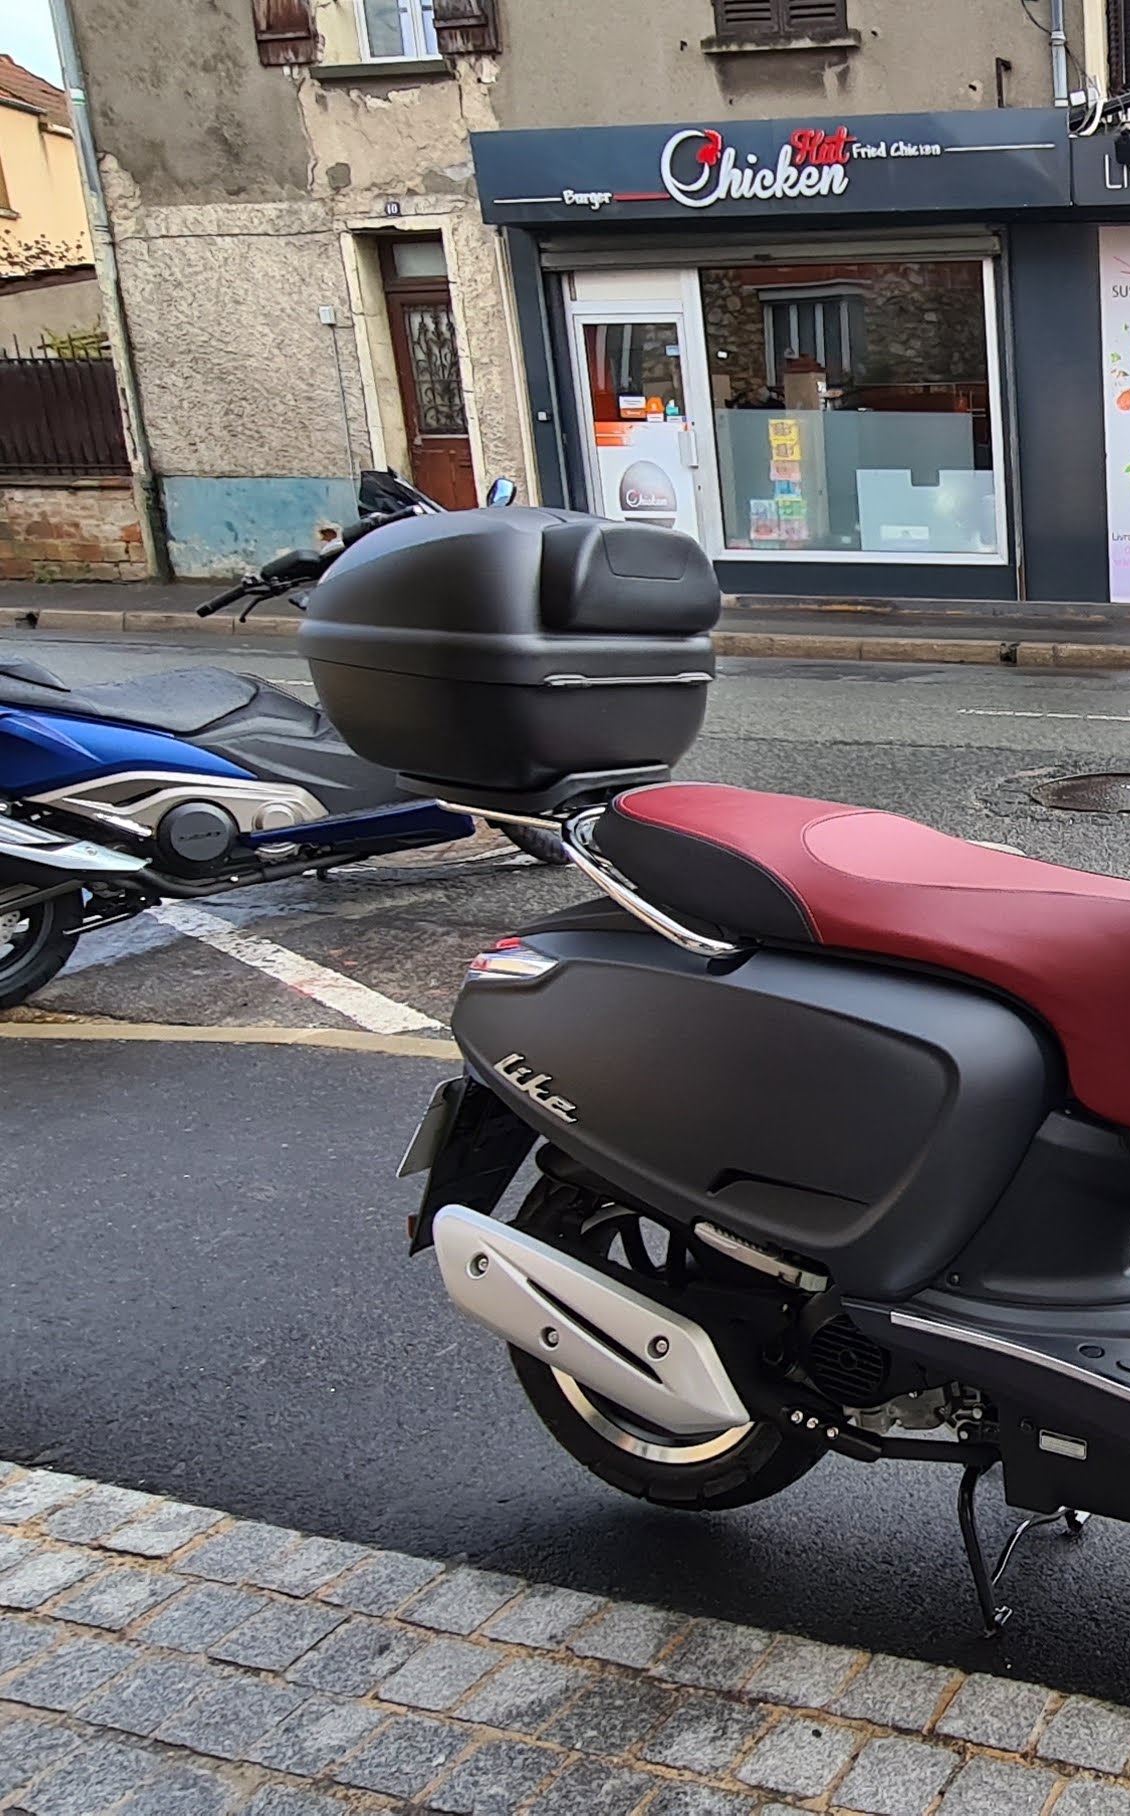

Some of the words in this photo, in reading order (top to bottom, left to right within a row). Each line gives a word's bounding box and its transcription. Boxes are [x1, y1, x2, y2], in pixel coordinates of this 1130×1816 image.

[852, 141, 887, 158] Fried
[889, 141, 941, 157] Chicken
[661, 129, 849, 208] Chicken
[387, 203, 398, 215] 10
[562, 189, 613, 210] Burger
